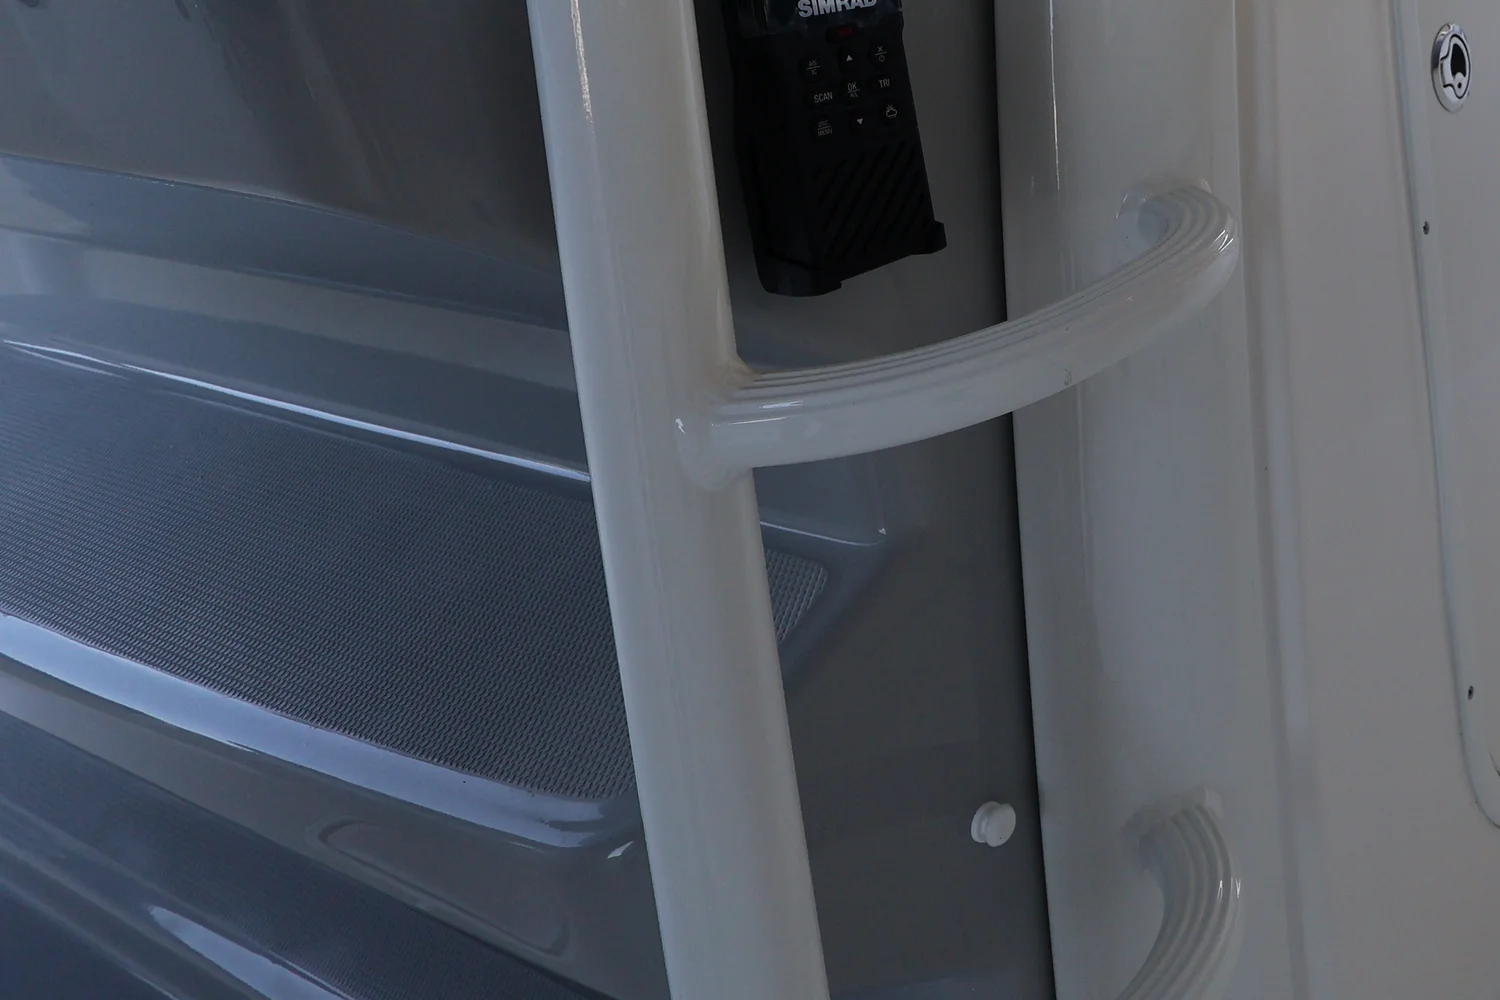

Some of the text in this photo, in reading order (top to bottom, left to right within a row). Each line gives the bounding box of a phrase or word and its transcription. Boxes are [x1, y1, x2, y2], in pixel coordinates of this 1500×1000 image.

[847, 81, 858, 91] OK
[878, 78, 892, 89] TRI
[813, 91, 833, 103] SCAN
